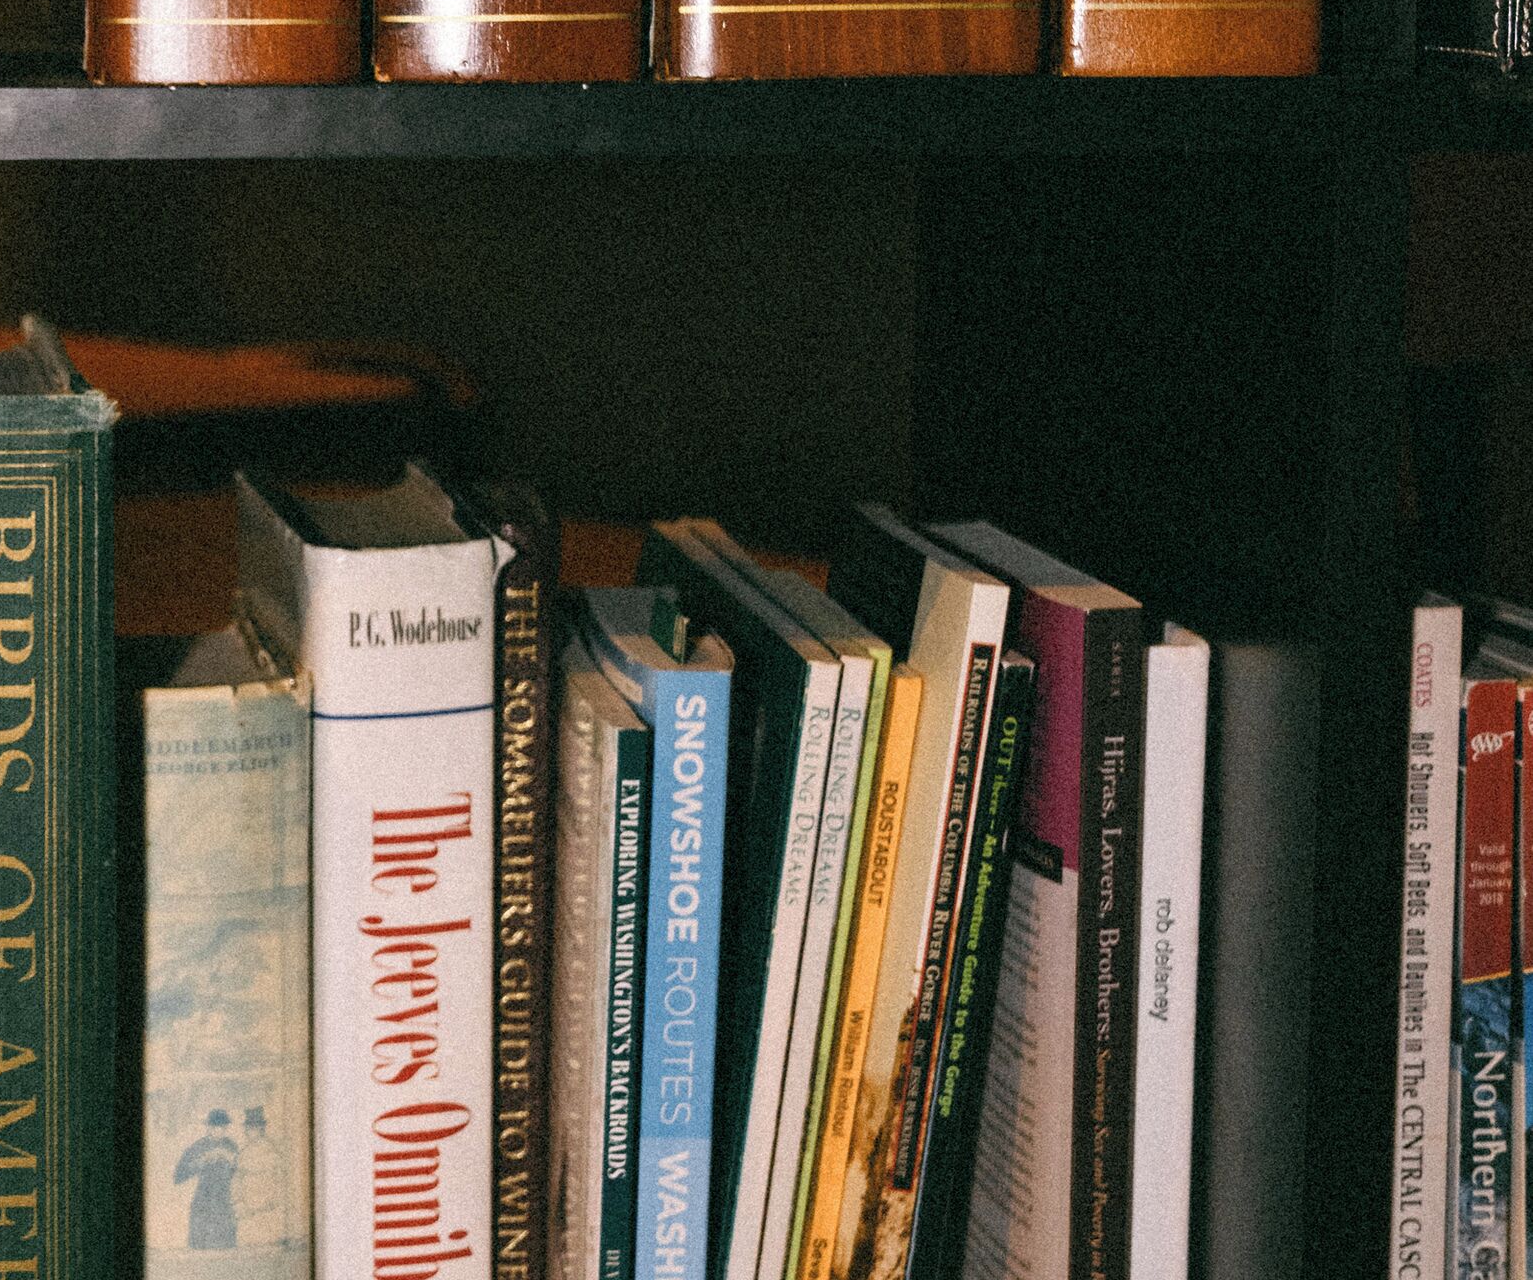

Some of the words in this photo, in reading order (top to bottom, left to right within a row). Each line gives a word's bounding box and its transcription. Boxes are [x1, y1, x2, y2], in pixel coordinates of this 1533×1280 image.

[348, 611, 362, 648] P.
[366, 612, 387, 646] G.
[389, 604, 482, 645] Wodehouse
[504, 580, 541, 662] THE
[959, 656, 990, 752] RAILROADS
[1414, 642, 1435, 708] COATES
[824, 704, 862, 802] ROLLING
[954, 754, 970, 776] OF
[995, 715, 1018, 773] OUT
[1410, 731, 1435, 756] Hot
[666, 693, 708, 945] SNOWSHOE
[949, 781, 966, 813] THE
[371, 791, 473, 894] The
[617, 777, 641, 899] EXPLORING
[813, 814, 846, 907] DREAMS
[866, 780, 901, 910] ROUSTABOUT
[934, 817, 963, 905] COLUMBIA
[982, 832, 998, 859] An
[1404, 840, 1432, 872] Soft
[926, 908, 950, 961] RIVER
[966, 861, 993, 951] Adventure
[1155, 897, 1172, 934] rob
[610, 901, 640, 1056] WASHINGTON'S
[957, 954, 979, 1005] Guide
[1148, 937, 1172, 1022] delaney
[1403, 928, 1428, 959] and
[358, 915, 473, 1085] Jeeves
[918, 964, 942, 1022] GORGE
[954, 1009, 969, 1030] to
[1096, 926, 1120, 1042] Brothers:
[1401, 962, 1429, 1034] Dayhikes
[499, 958, 534, 1092] GUIDE
[660, 955, 699, 1127] ROUTES
[948, 1032, 968, 1061] the
[1402, 1038, 1425, 1055] in
[936, 1064, 961, 1118] Gorge
[1401, 1058, 1426, 1099] The
[498, 1107, 531, 1163] TO
[607, 1059, 632, 1181] BACKROADS
[1470, 1050, 1508, 1227] Northern
[1399, 1104, 1425, 1212] CENTRAL
